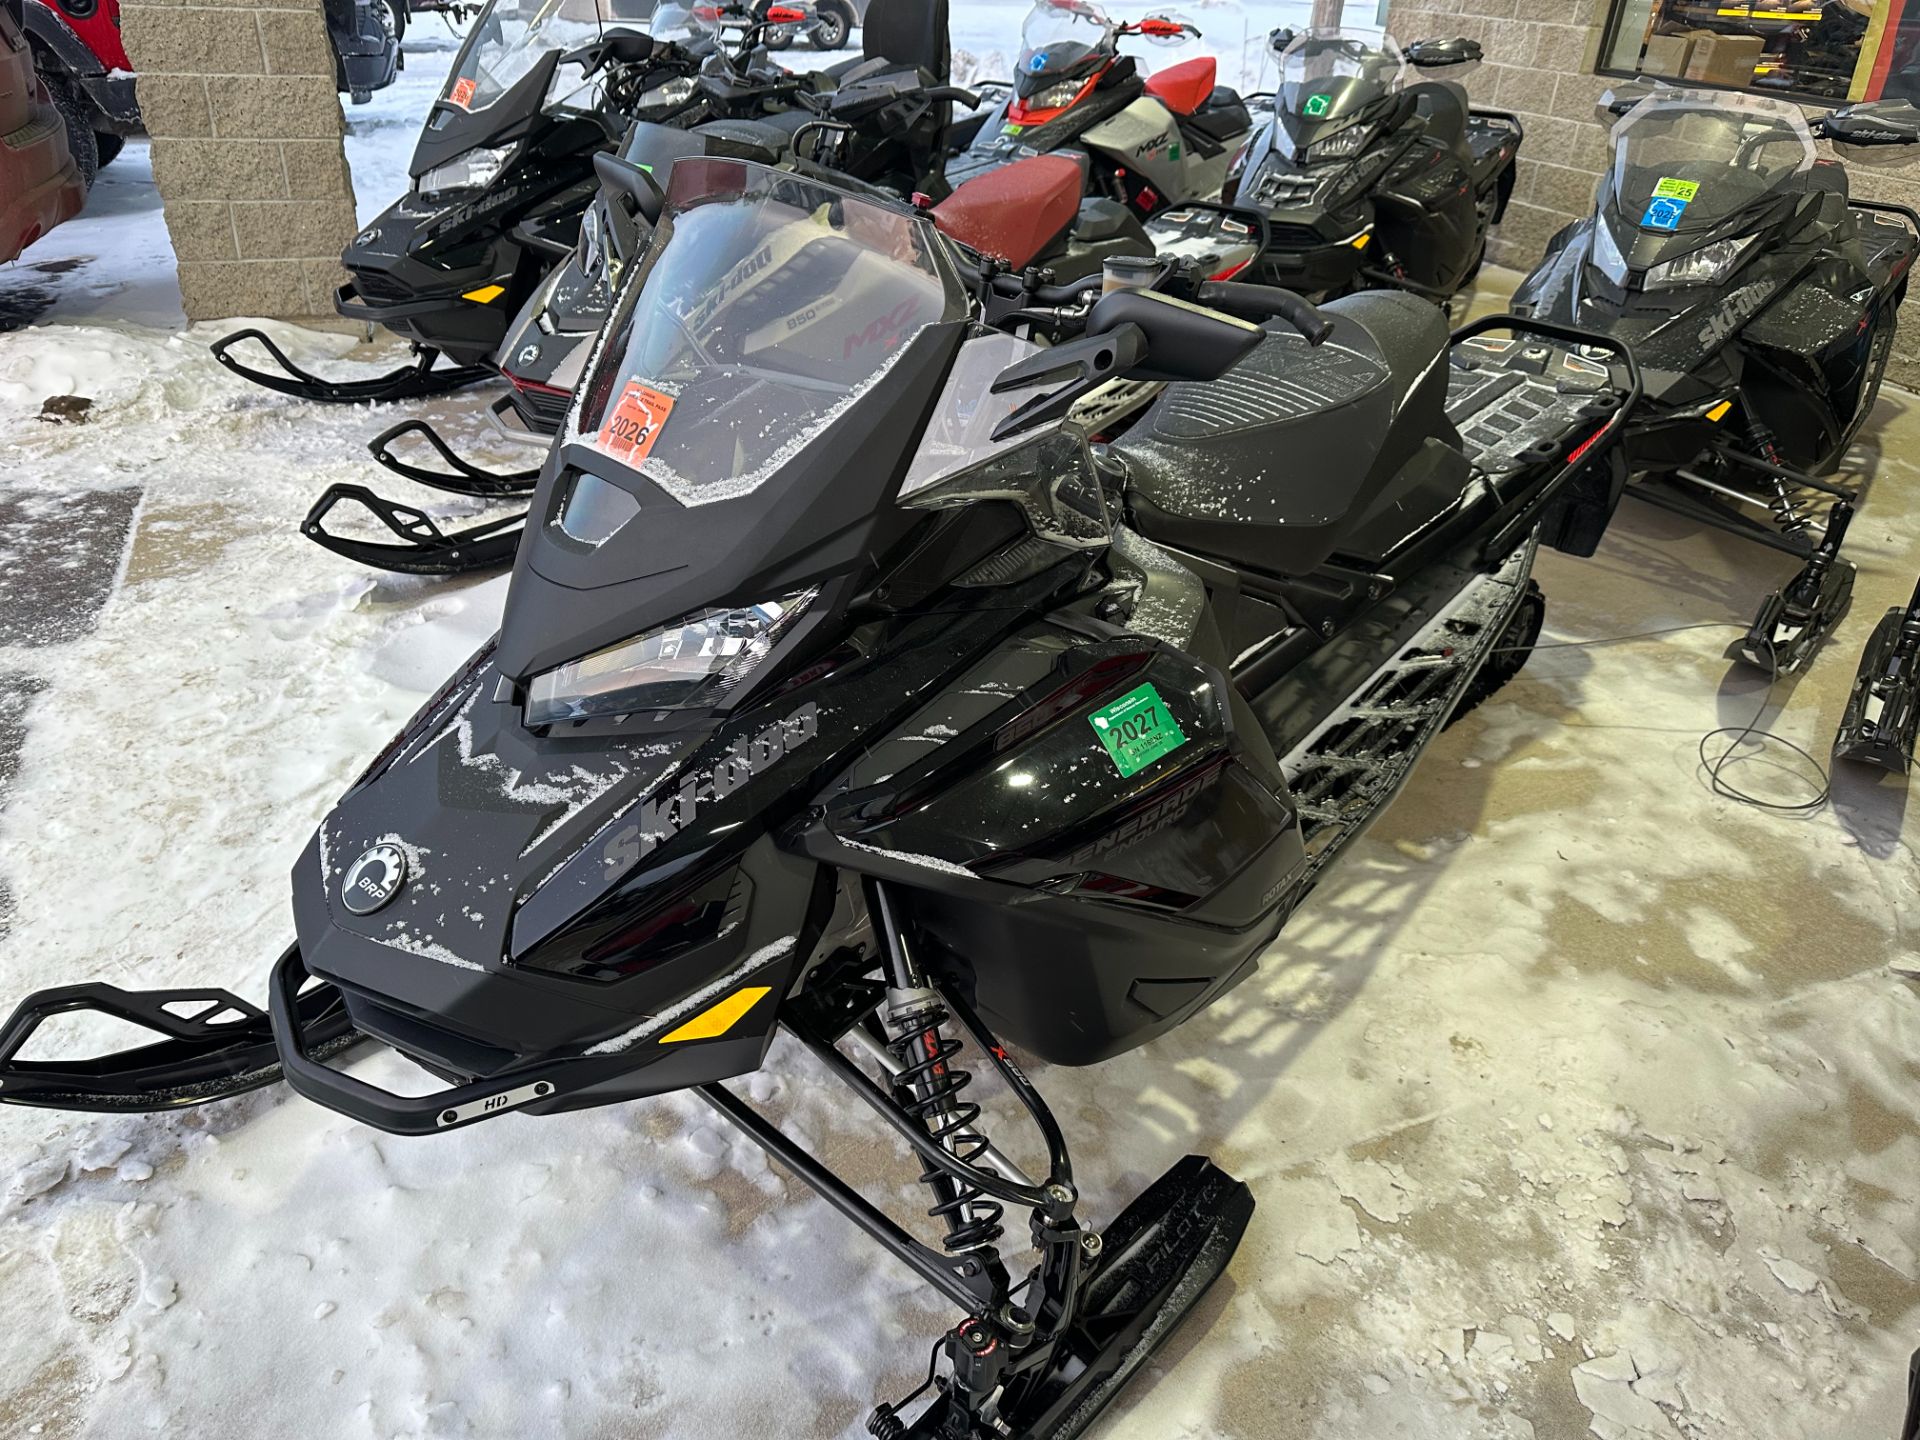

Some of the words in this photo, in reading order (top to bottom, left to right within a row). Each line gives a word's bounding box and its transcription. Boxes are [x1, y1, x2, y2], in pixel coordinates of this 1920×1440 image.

[1676, 187, 1693, 197] 25
[786, 308, 817, 331] 850
[609, 415, 650, 446] 2026
[1109, 696, 1137, 714] Wisconsin
[1109, 705, 1159, 750] 2027
[1104, 803, 1188, 862] ENDURO
[357, 876, 386, 900] BRP
[1262, 873, 1293, 906] ROTAX
[484, 1095, 509, 1111] HD
